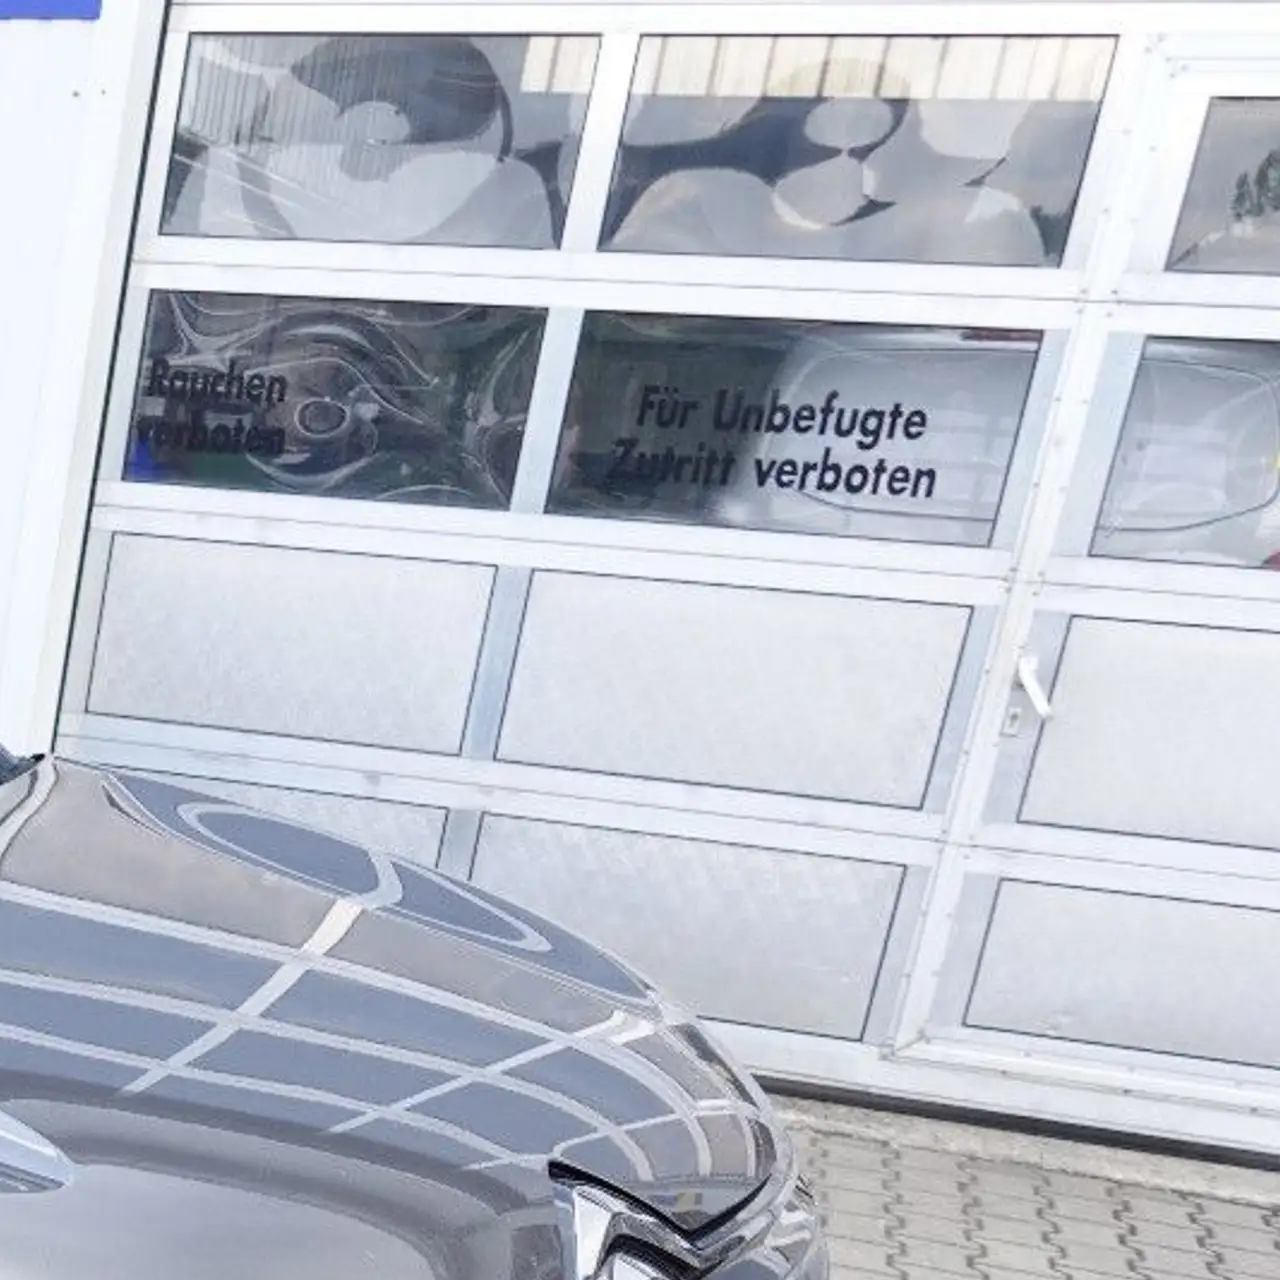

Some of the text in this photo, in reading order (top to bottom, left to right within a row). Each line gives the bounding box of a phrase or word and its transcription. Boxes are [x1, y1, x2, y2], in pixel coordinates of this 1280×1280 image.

[149, 357, 288, 403] Rauchen
[636, 384, 927, 450] Für Unbefugte
[605, 437, 936, 498] Zutritt verboten
